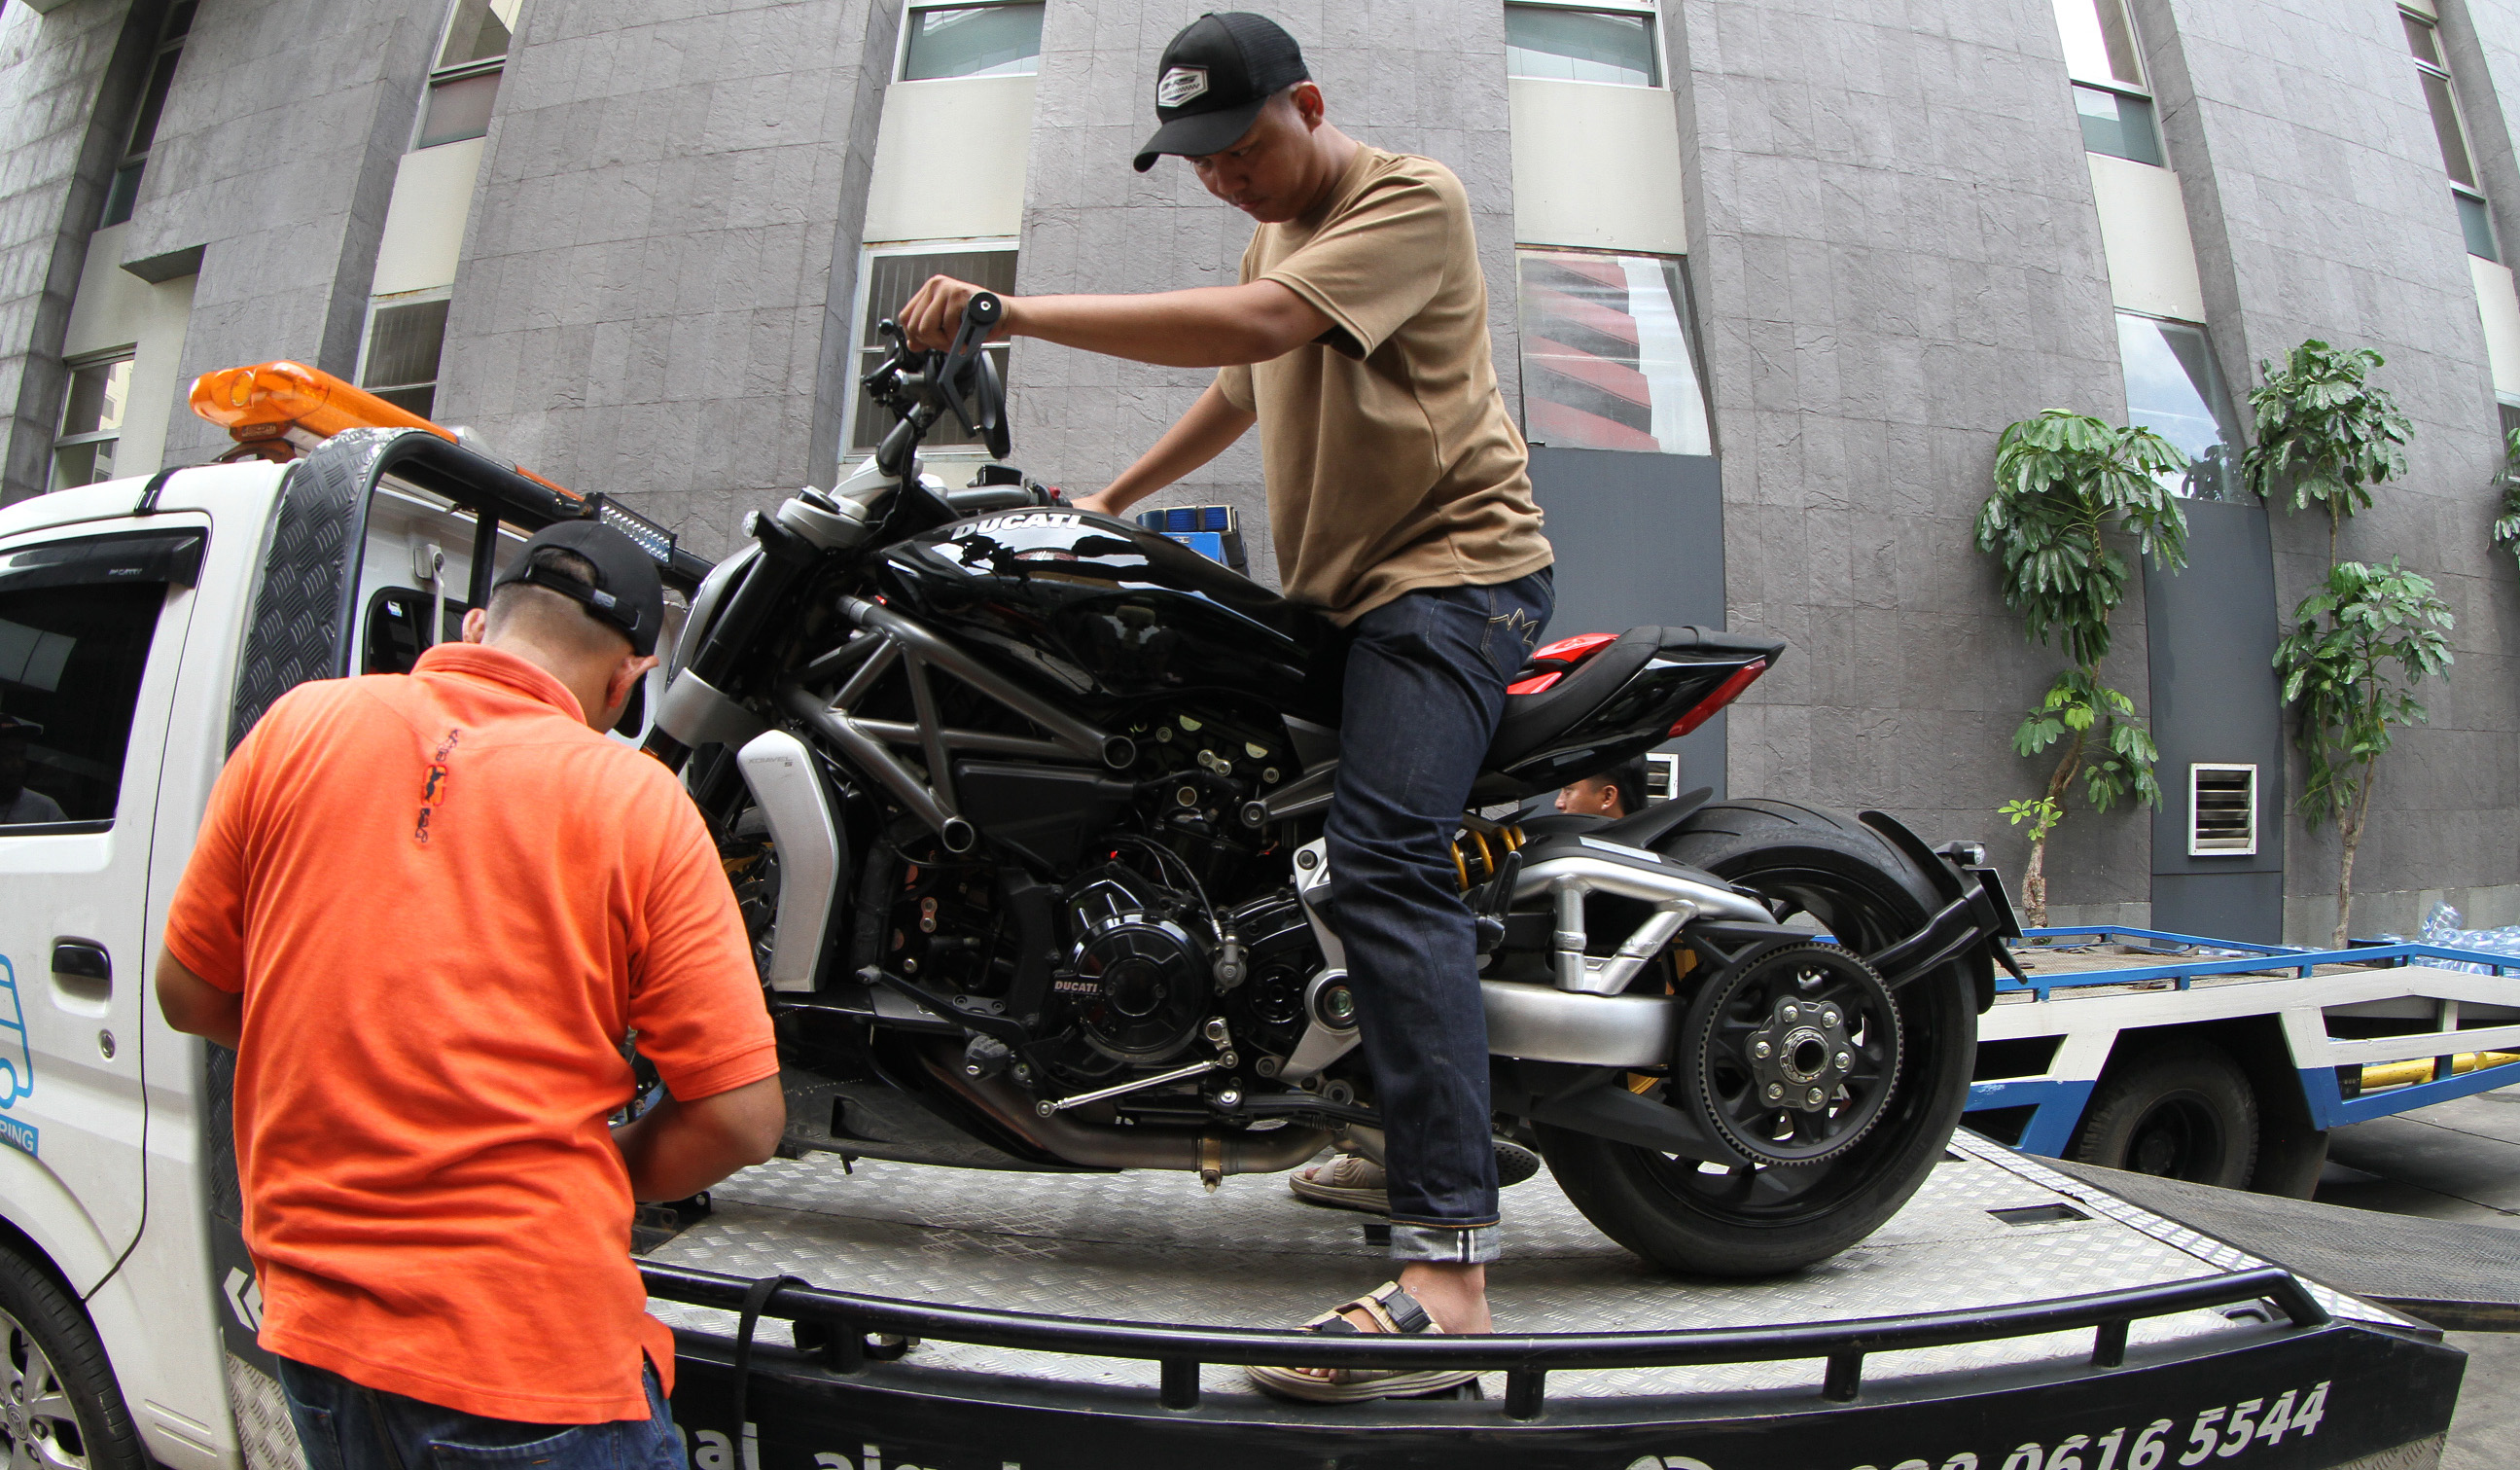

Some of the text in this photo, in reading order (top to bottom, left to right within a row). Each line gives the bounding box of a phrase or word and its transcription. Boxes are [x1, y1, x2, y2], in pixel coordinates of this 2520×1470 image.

[951, 514, 1081, 540] DUCATI
[1054, 981, 1098, 992] DUCATI
[2178, 1380, 2331, 1466] 5544
